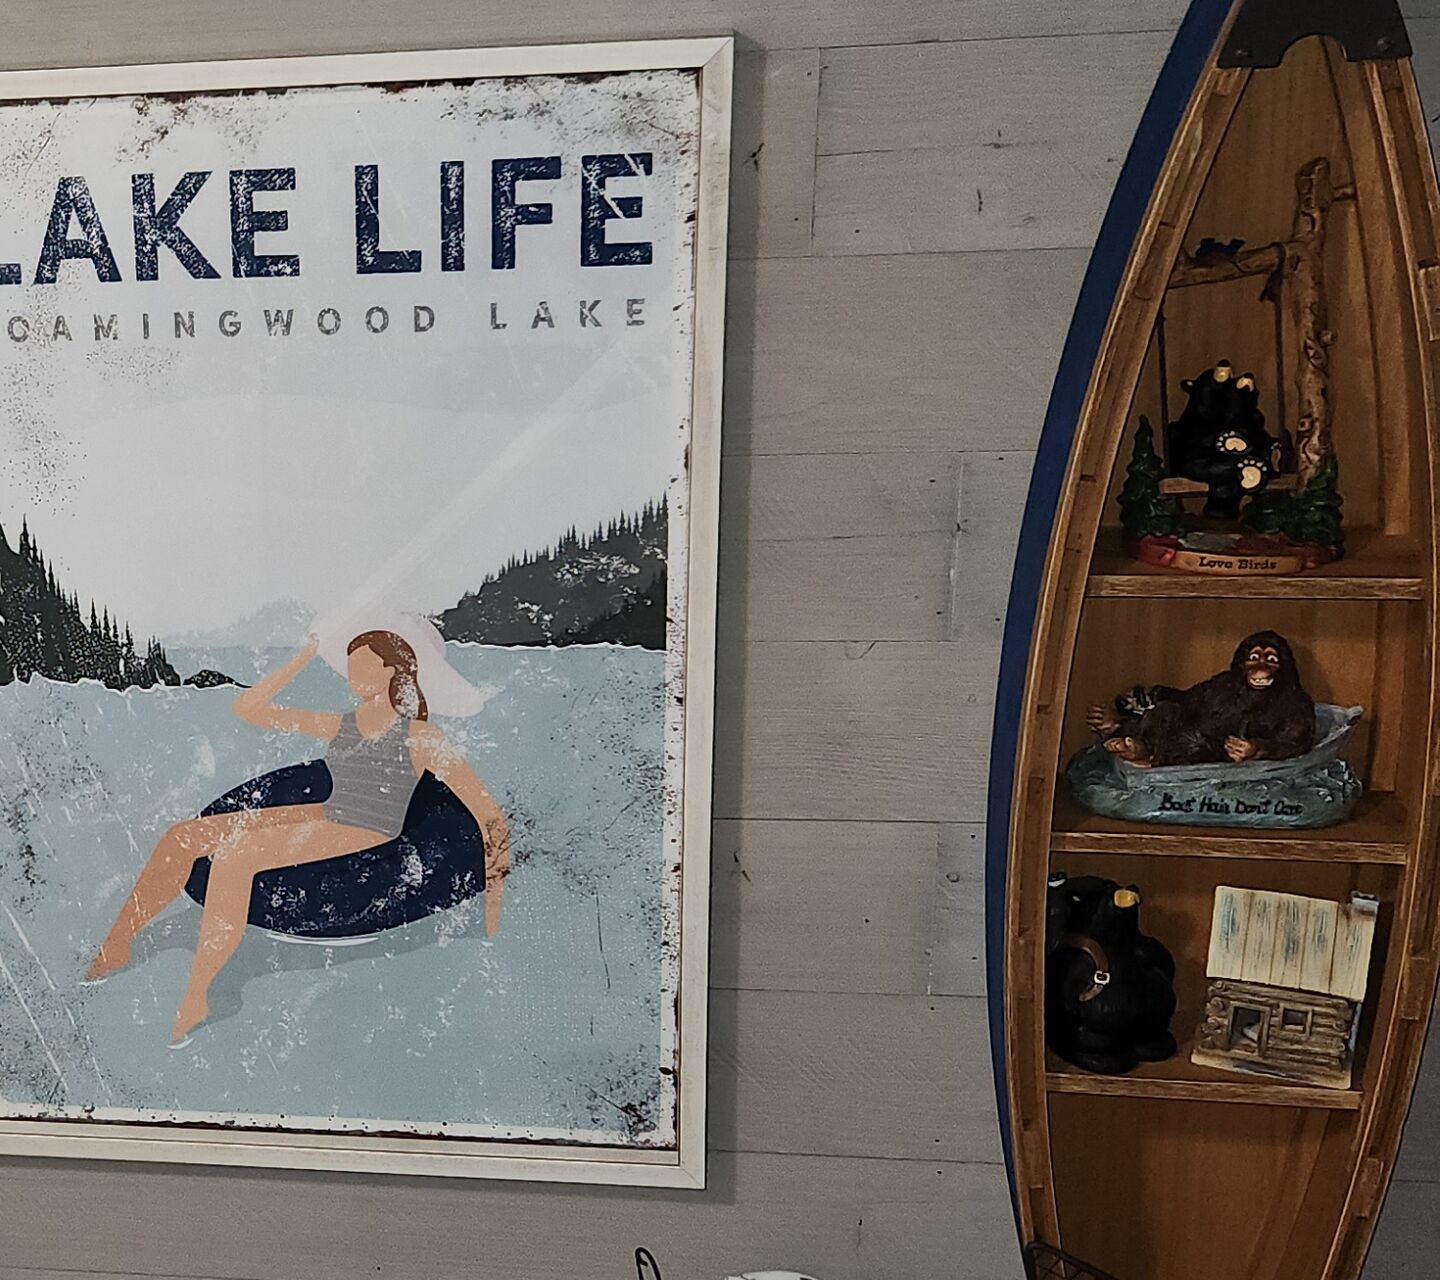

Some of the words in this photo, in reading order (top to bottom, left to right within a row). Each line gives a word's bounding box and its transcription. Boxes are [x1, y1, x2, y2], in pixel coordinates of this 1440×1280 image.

[354, 151, 654, 276] LIFE
[489, 297, 647, 332] LAKE
[1198, 556, 1233, 569] Love
[1238, 558, 1278, 570] Birds
